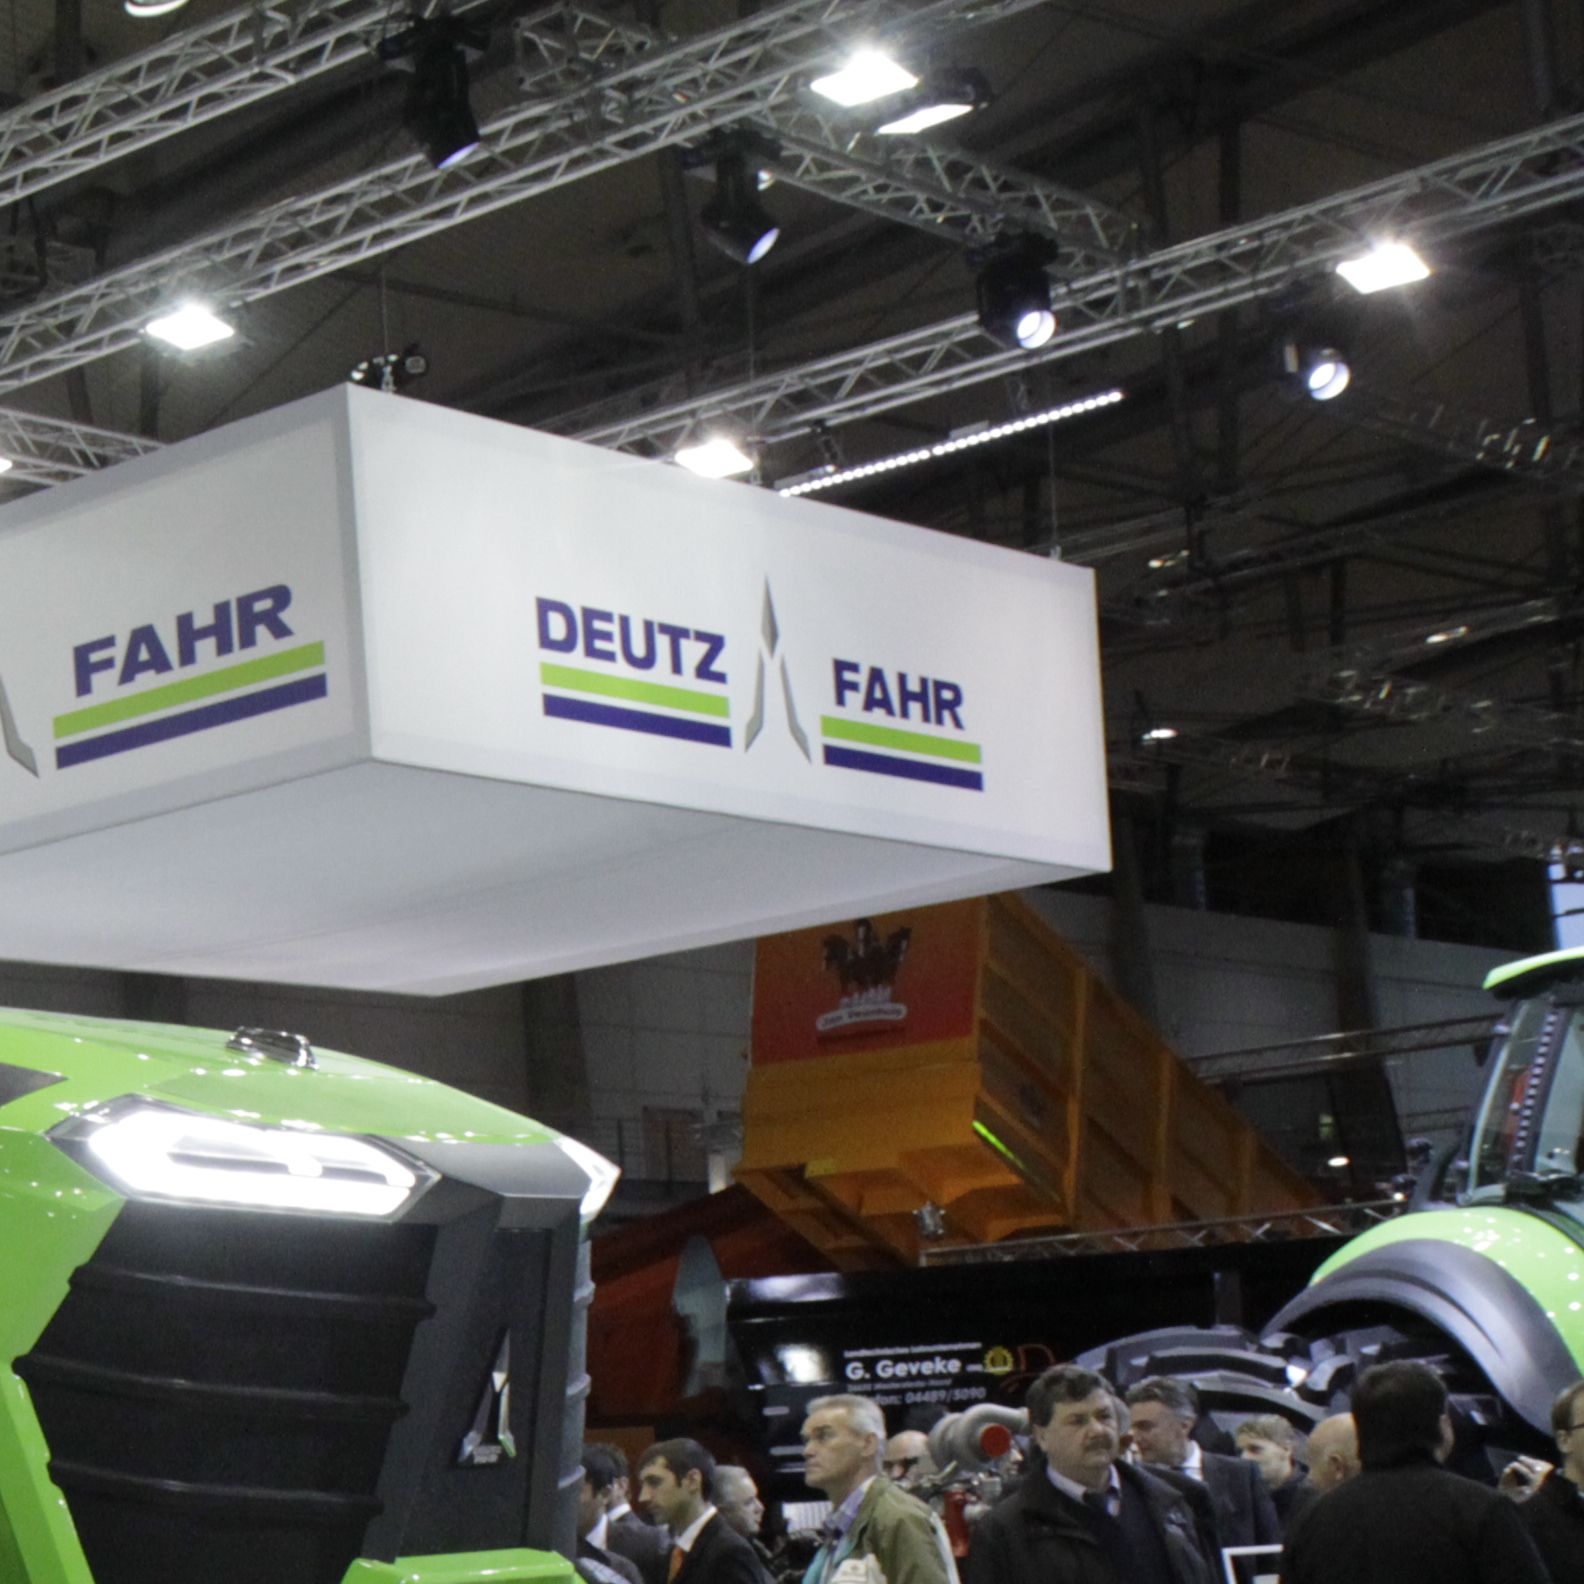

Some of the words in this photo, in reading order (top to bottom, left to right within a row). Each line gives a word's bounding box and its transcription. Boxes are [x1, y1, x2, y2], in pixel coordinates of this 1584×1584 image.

[73, 584, 295, 699] FAHR
[535, 596, 728, 685] DEUTZ
[832, 657, 966, 730] FAHR
[845, 1360, 871, 1381] G.
[875, 1355, 962, 1378] Geveke
